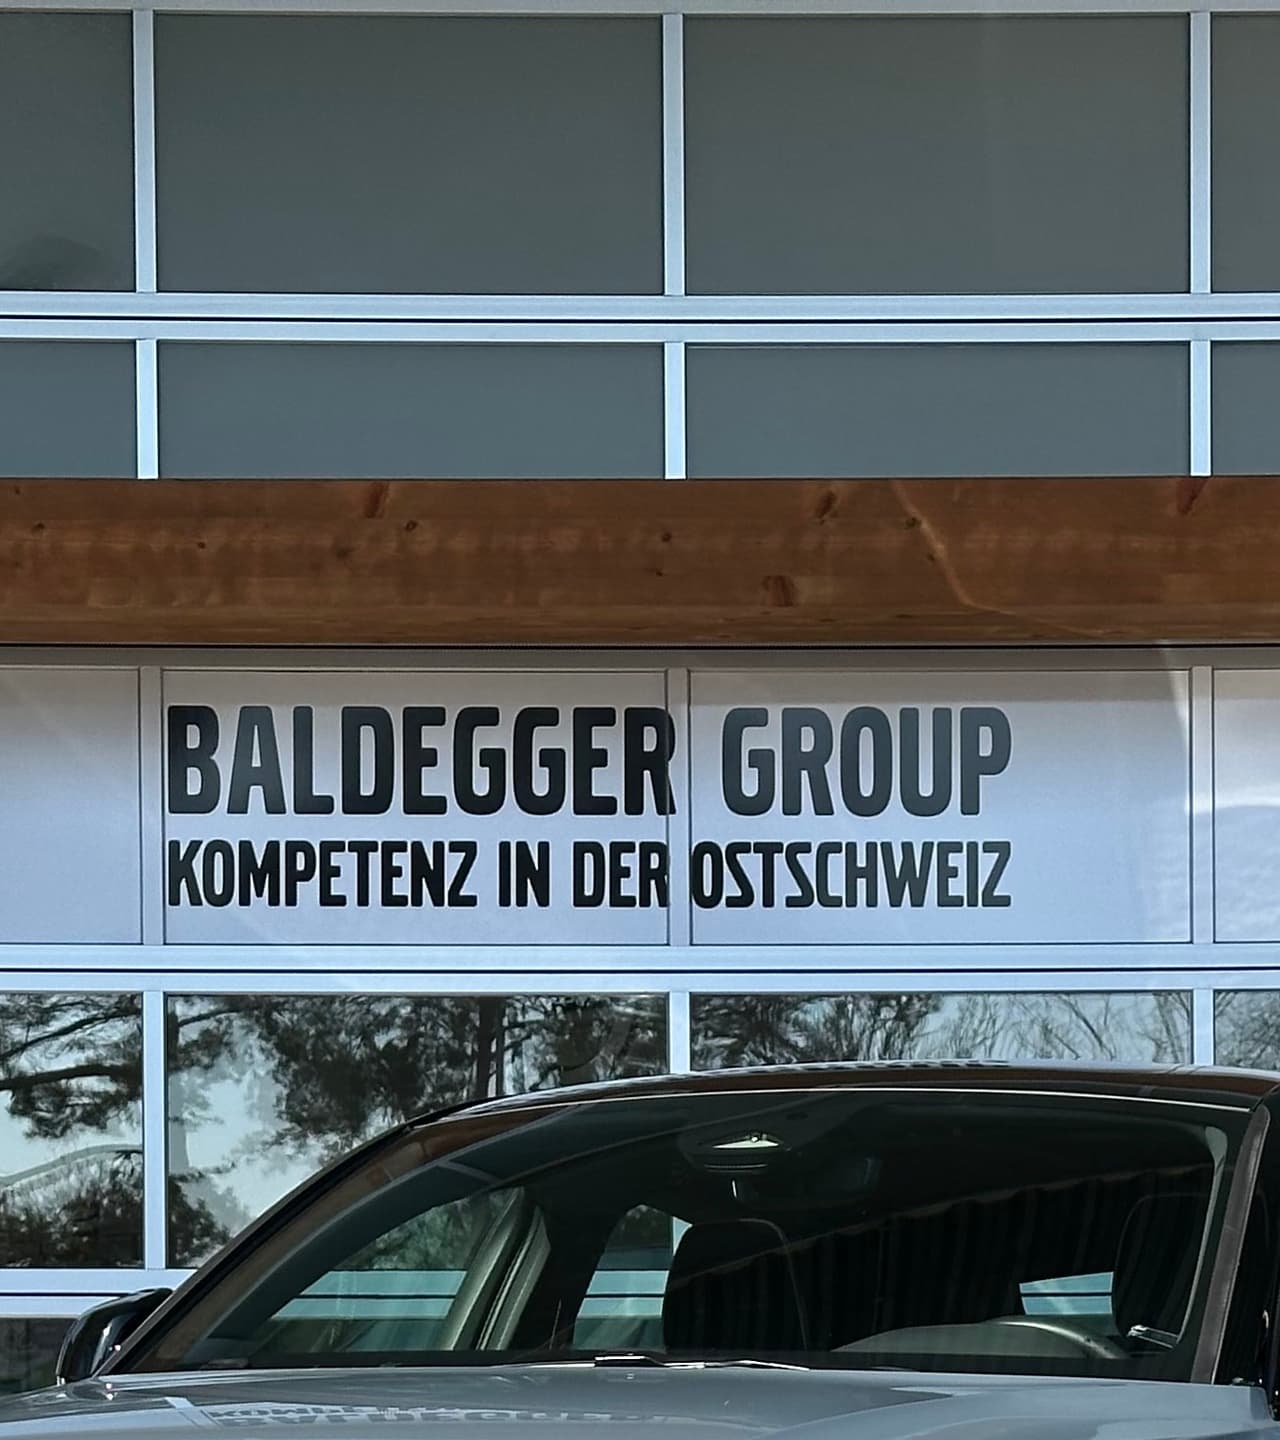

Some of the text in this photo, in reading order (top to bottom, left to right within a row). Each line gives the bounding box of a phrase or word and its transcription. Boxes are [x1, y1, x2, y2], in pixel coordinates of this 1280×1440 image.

[166, 706, 1013, 817] BALDEGGER GROUP
[166, 839, 1013, 908] KOMPETENZ IN DER OSTSCHWEIZ
